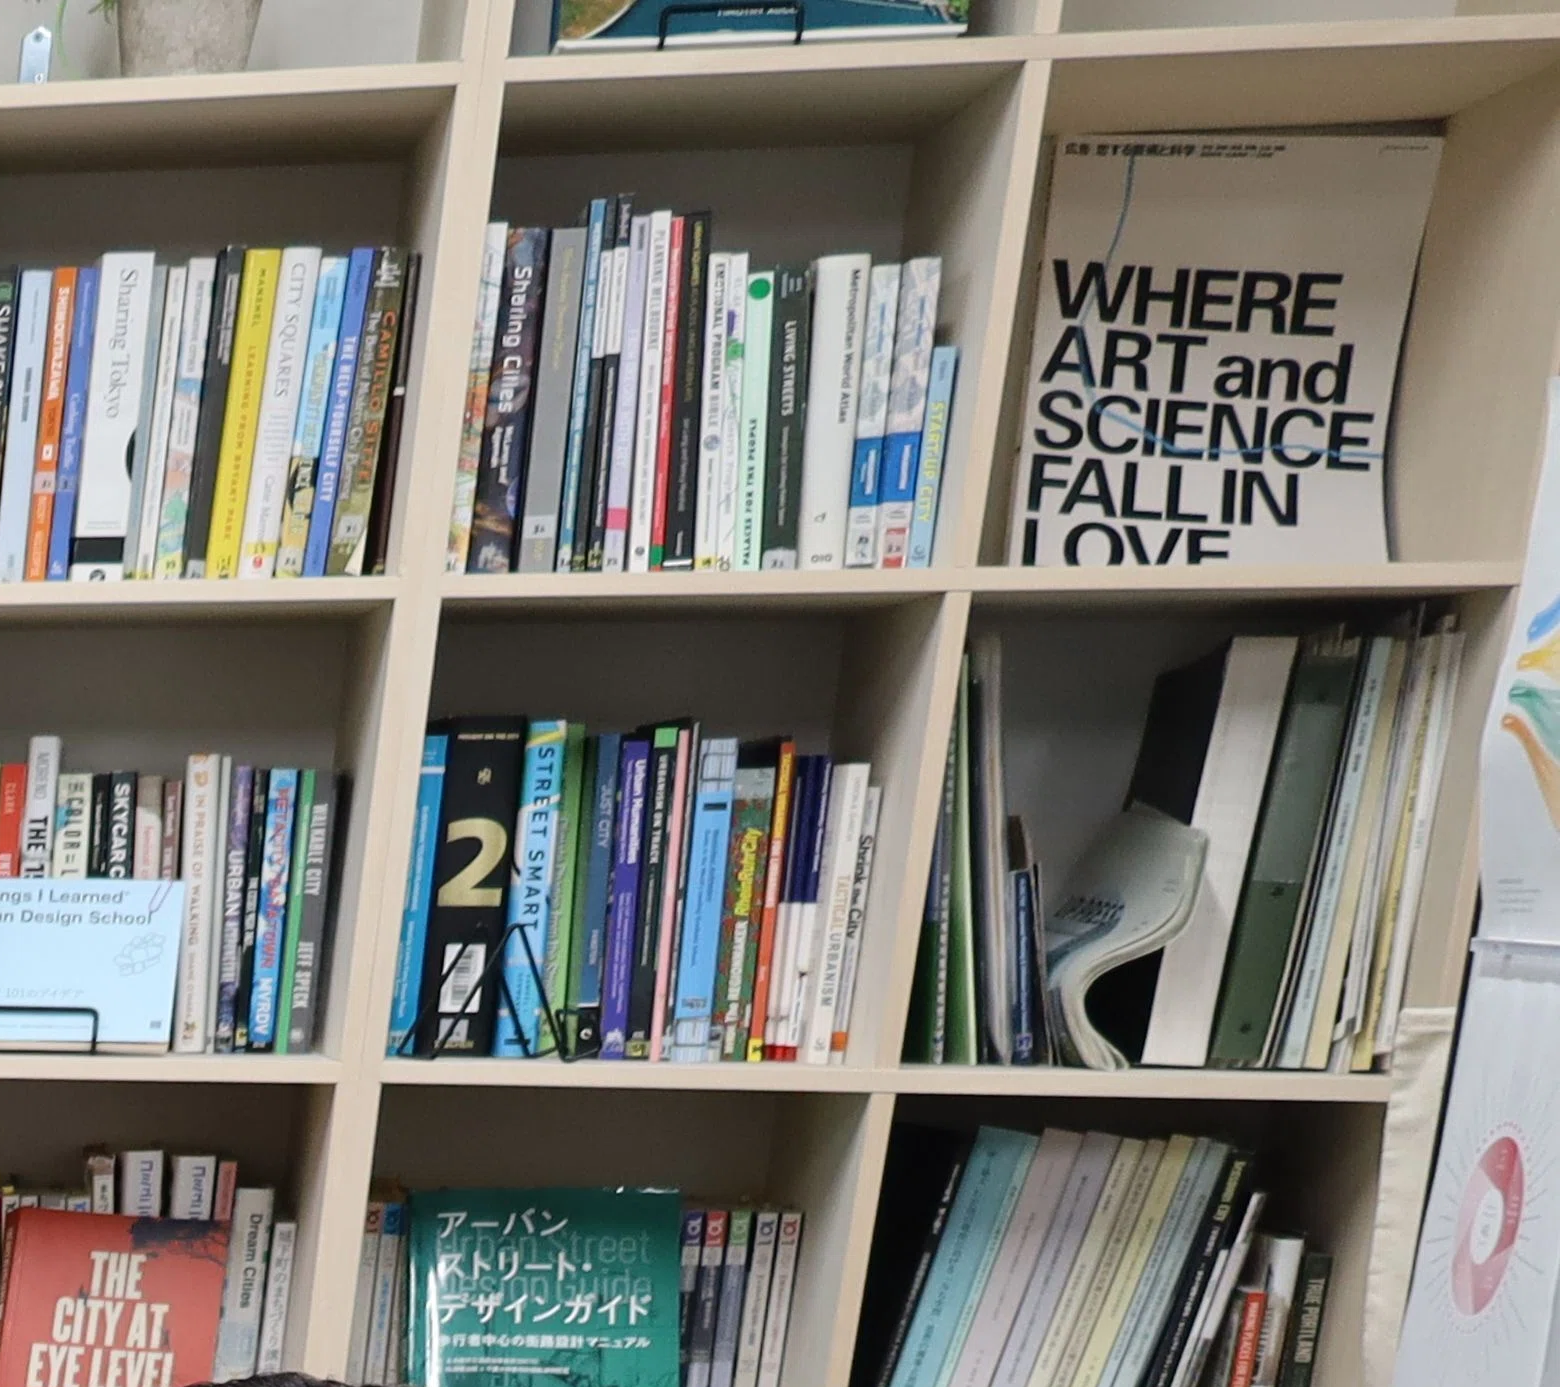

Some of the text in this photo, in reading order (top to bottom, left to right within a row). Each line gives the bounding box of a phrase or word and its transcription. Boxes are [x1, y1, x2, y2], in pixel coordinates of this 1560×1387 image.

[275, 262, 307, 398] CITY SQUARES
[1052, 258, 1344, 336] WHERE
[105, 267, 141, 420] Sharing Tokyo
[498, 266, 532, 415] Sharing Cities
[780, 320, 798, 418] LIVING STREETS
[836, 268, 863, 424] Metropolitan World Atlas
[1040, 326, 1354, 405] ART and
[356, 310, 396, 484] CAMILLO SITTE
[1034, 390, 1374, 472] SCIENCE
[741, 417, 758, 566] PALACES PEOPLE
[1027, 454, 1299, 526] FALL IN
[27, 815, 48, 864] THE
[188, 811, 205, 946] PRAISE WALKING
[437, 817, 508, 908] 2
[518, 745, 555, 933] STREET SMART
[853, 834, 874, 887] Shrink
[21, 910, 83, 926] Design
[89, 909, 153, 925] School
[38, 889, 43, 903] I
[49, 889, 123, 904] Learned
[290, 868, 322, 1008] CITY JEFF SPECK
[238, 1213, 263, 1309] Dream Cities
[437, 1209, 569, 1239] アーバン
[547, 1231, 651, 1264] Street
[90, 1251, 147, 1299] THE
[439, 1294, 653, 1325] デザインガイド
[555, 1268, 653, 1305] Guide
[52, 1297, 169, 1350] CITY AT
[438, 1335, 651, 1350] 歩行者中心の街路設計マニュアル
[1293, 1277, 1326, 1364] TRUE PORTLAND
